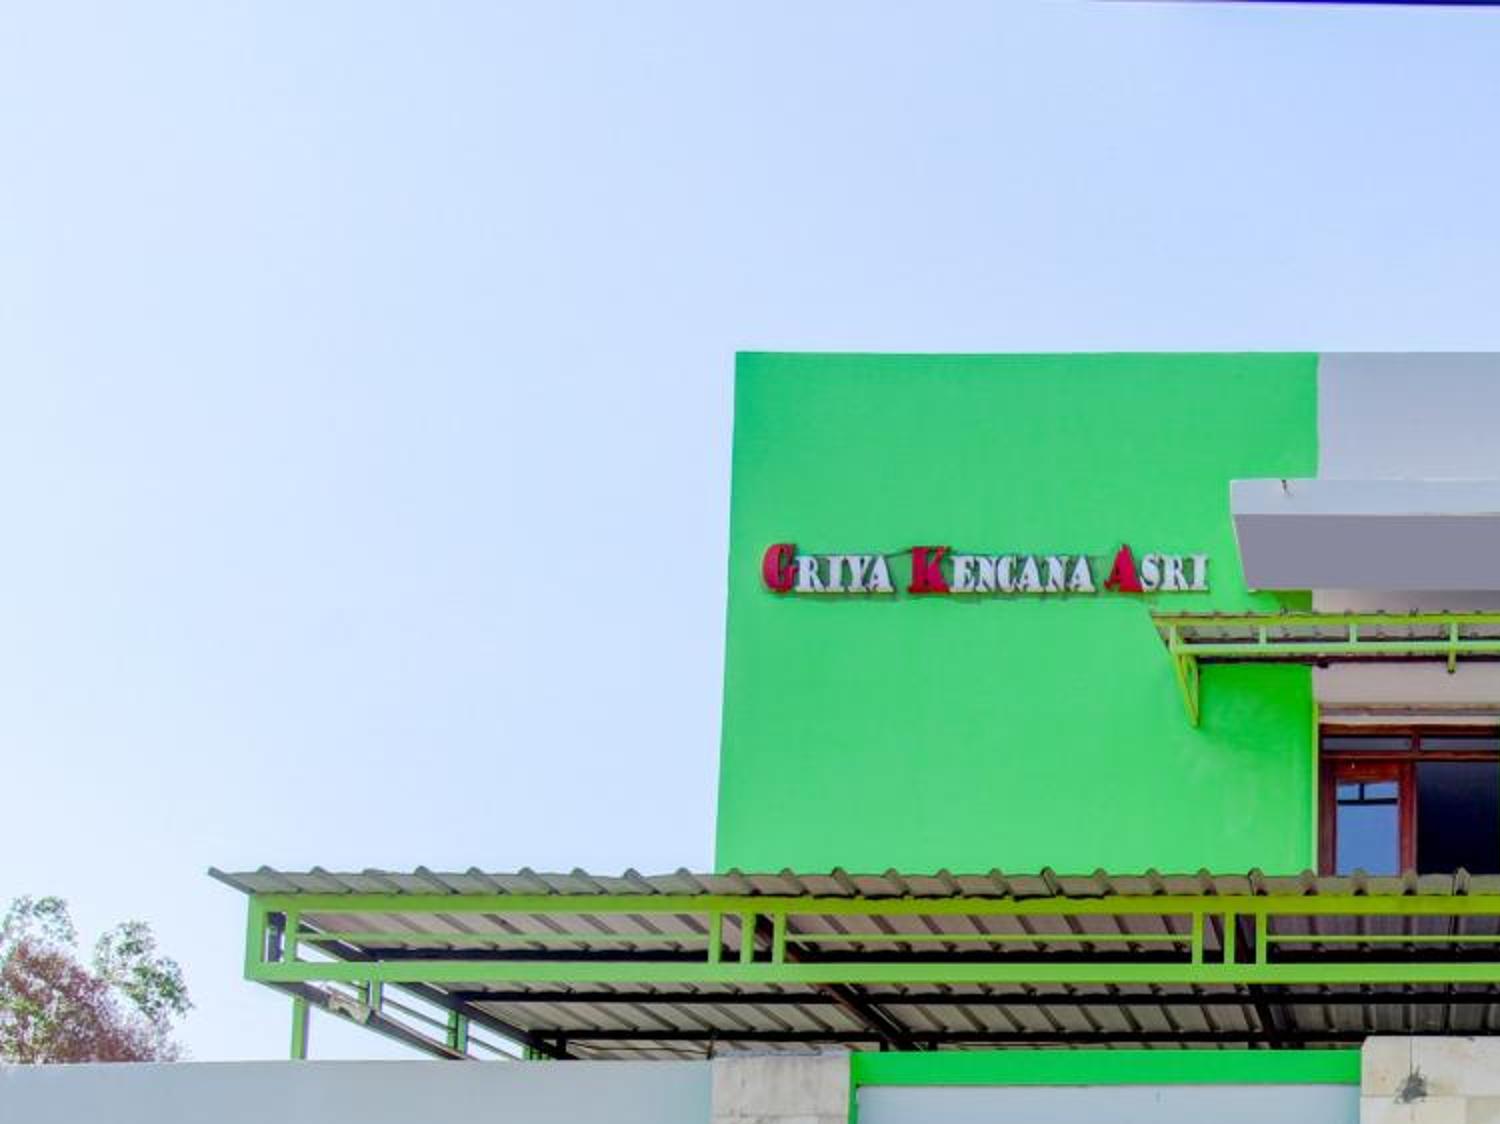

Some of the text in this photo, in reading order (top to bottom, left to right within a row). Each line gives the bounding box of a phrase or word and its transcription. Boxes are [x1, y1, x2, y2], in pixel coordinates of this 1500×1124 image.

[762, 543, 1210, 594] GRIYA KENCANA ASRI
